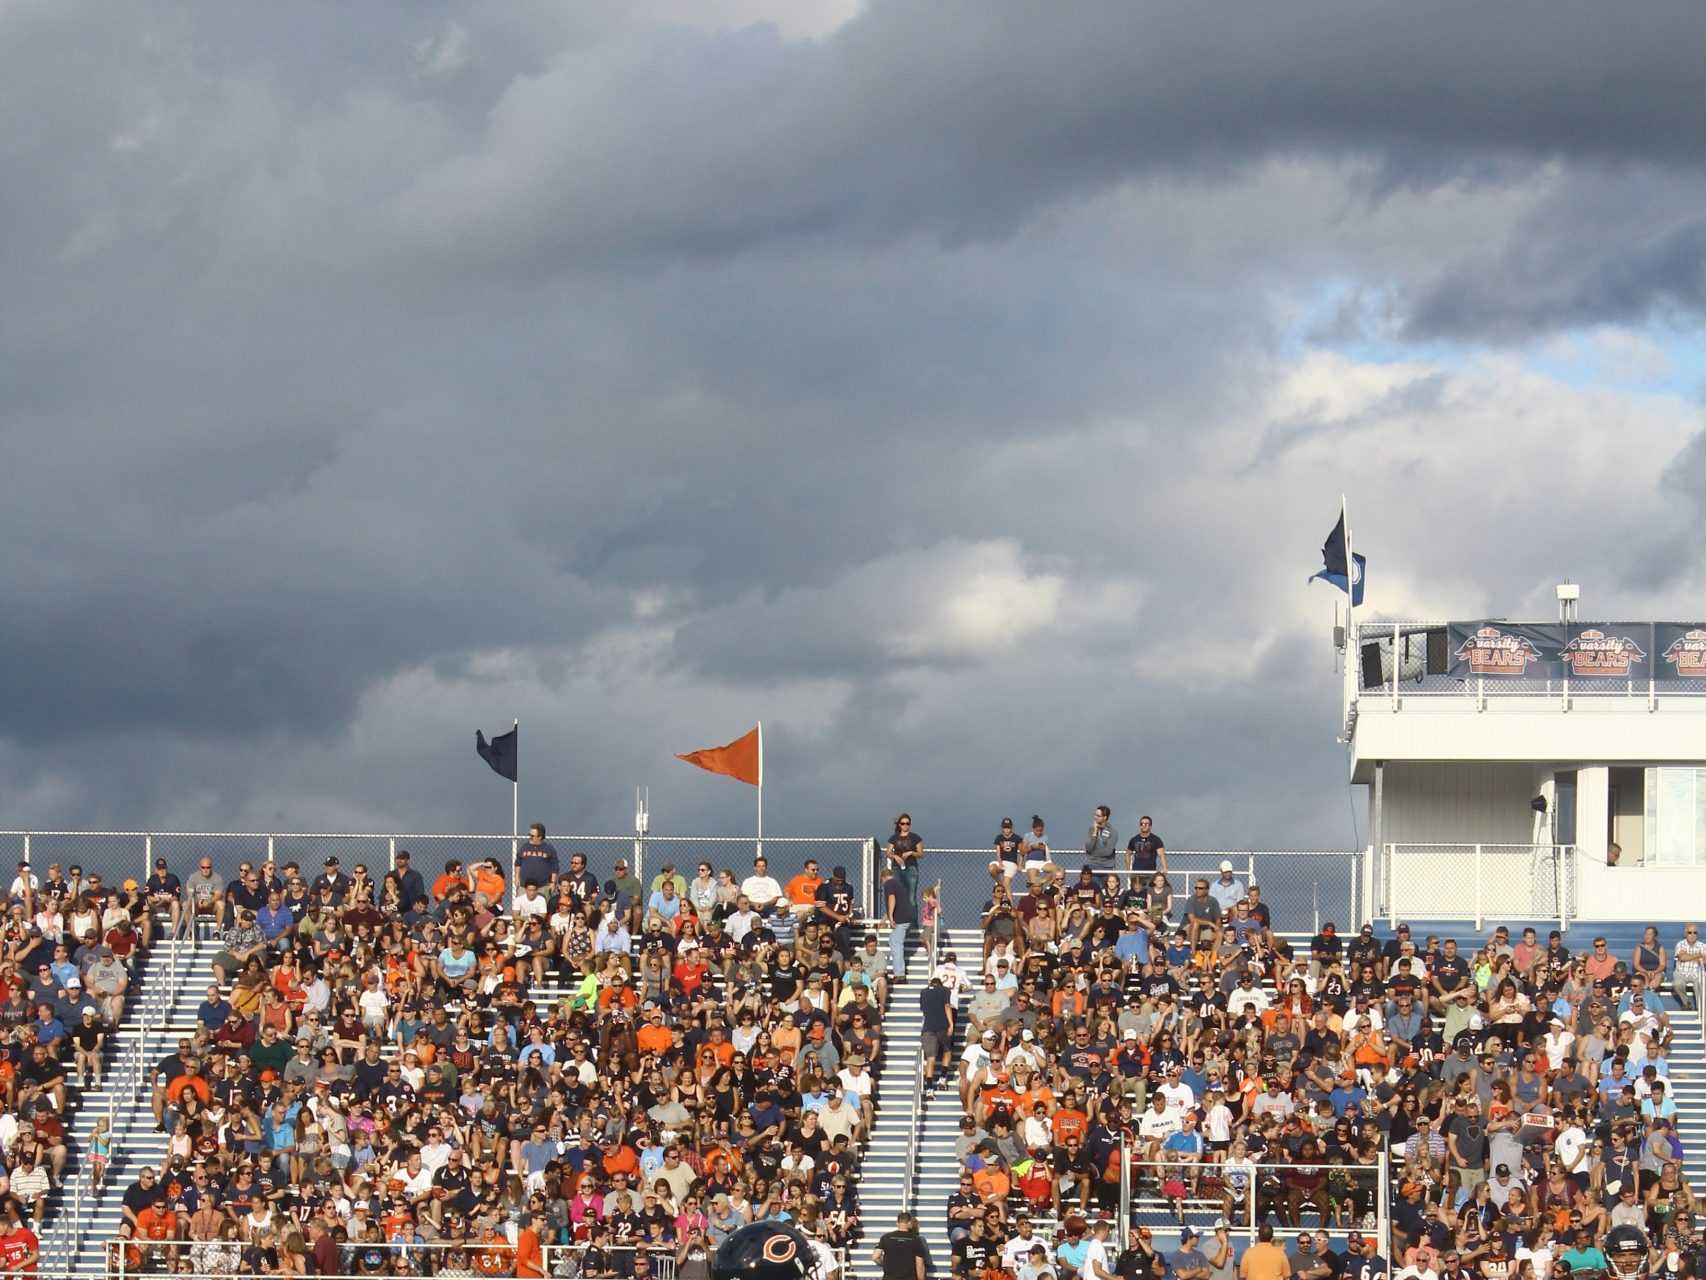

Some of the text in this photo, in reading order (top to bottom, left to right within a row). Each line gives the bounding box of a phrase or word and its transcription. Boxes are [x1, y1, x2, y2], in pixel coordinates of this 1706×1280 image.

[1476, 638, 1521, 652] varsity
[1580, 640, 1624, 654] varsity
[1471, 650, 1525, 666] BEARS
[1574, 651, 1629, 667] BEARS
[833, 893, 849, 912] 75
[1328, 982, 1341, 996] 23
[300, 1206, 311, 1221] 17
[763, 1234, 797, 1264] C
